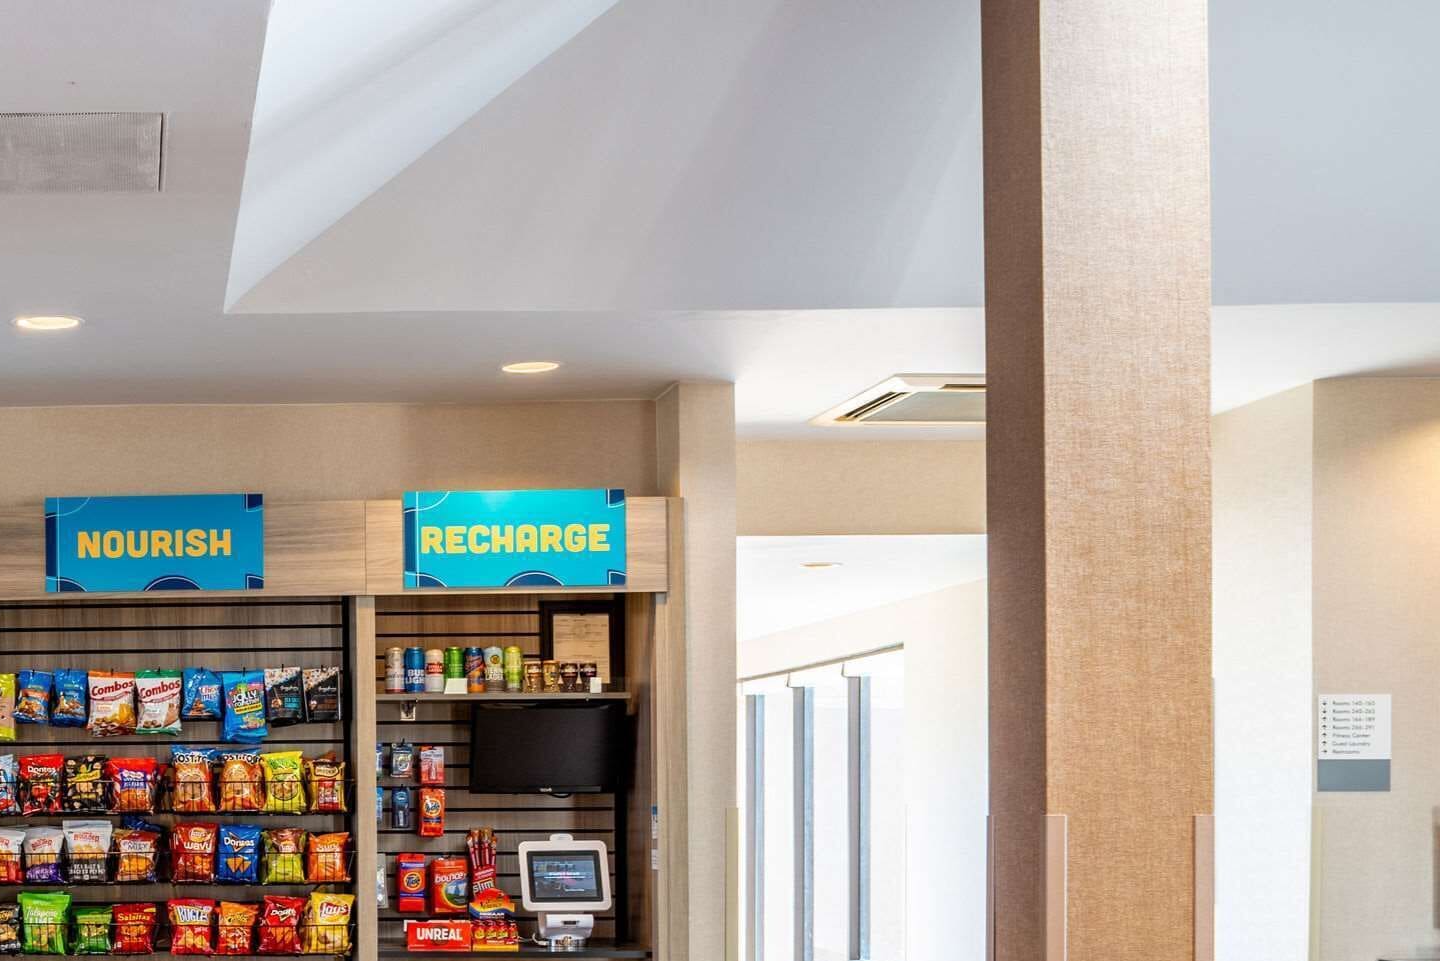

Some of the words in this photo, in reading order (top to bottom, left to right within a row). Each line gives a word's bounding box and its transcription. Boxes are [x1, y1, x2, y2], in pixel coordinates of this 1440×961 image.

[76, 528, 233, 559] NOURISH
[420, 523, 611, 554] RECHARGE
[91, 680, 134, 697] Combos
[140, 680, 180, 699] Combos
[232, 689, 257, 703] JOLLY
[27, 765, 56, 774] Doritos
[184, 841, 213, 853] wavy
[223, 837, 255, 847] Doritos
[435, 872, 466, 883] bounce
[473, 880, 495, 893] slim
[320, 902, 349, 918] Lay's
[416, 927, 463, 941] UNREAL
